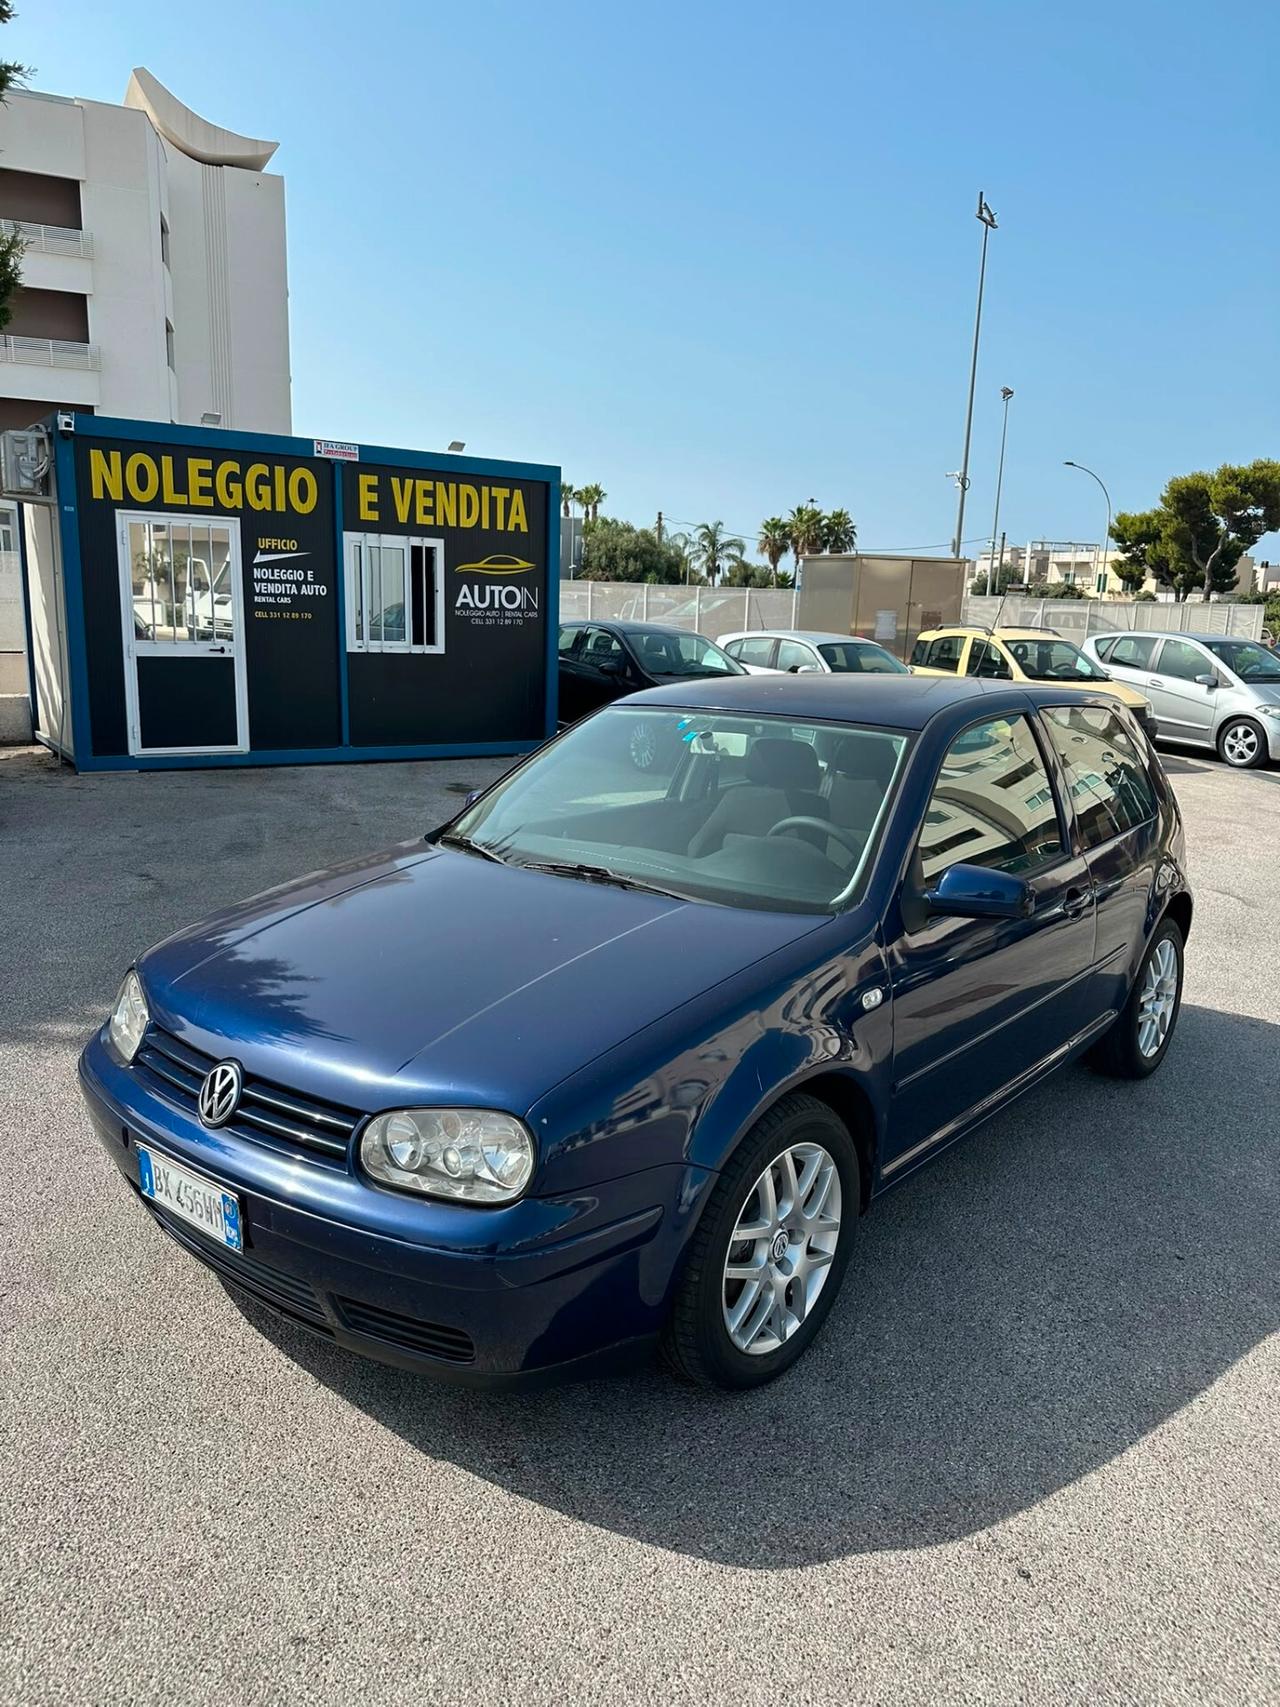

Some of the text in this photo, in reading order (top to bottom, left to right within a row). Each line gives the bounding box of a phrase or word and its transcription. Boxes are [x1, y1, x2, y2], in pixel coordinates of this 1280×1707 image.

[90, 449, 318, 514] NOLEGGIO
[359, 474, 528, 532] E VENDITA
[258, 537, 298, 551] UFFICIO
[253, 567, 314, 581] NOLEGGIO E
[253, 582, 327, 596] VENDITA AUTO
[254, 595, 276, 603] RENTAL
[455, 584, 539, 610] AUTOIN
[255, 610, 268, 618] CELL
[485, 610, 500, 618] AUTO
[153, 1164, 173, 1201] BX
